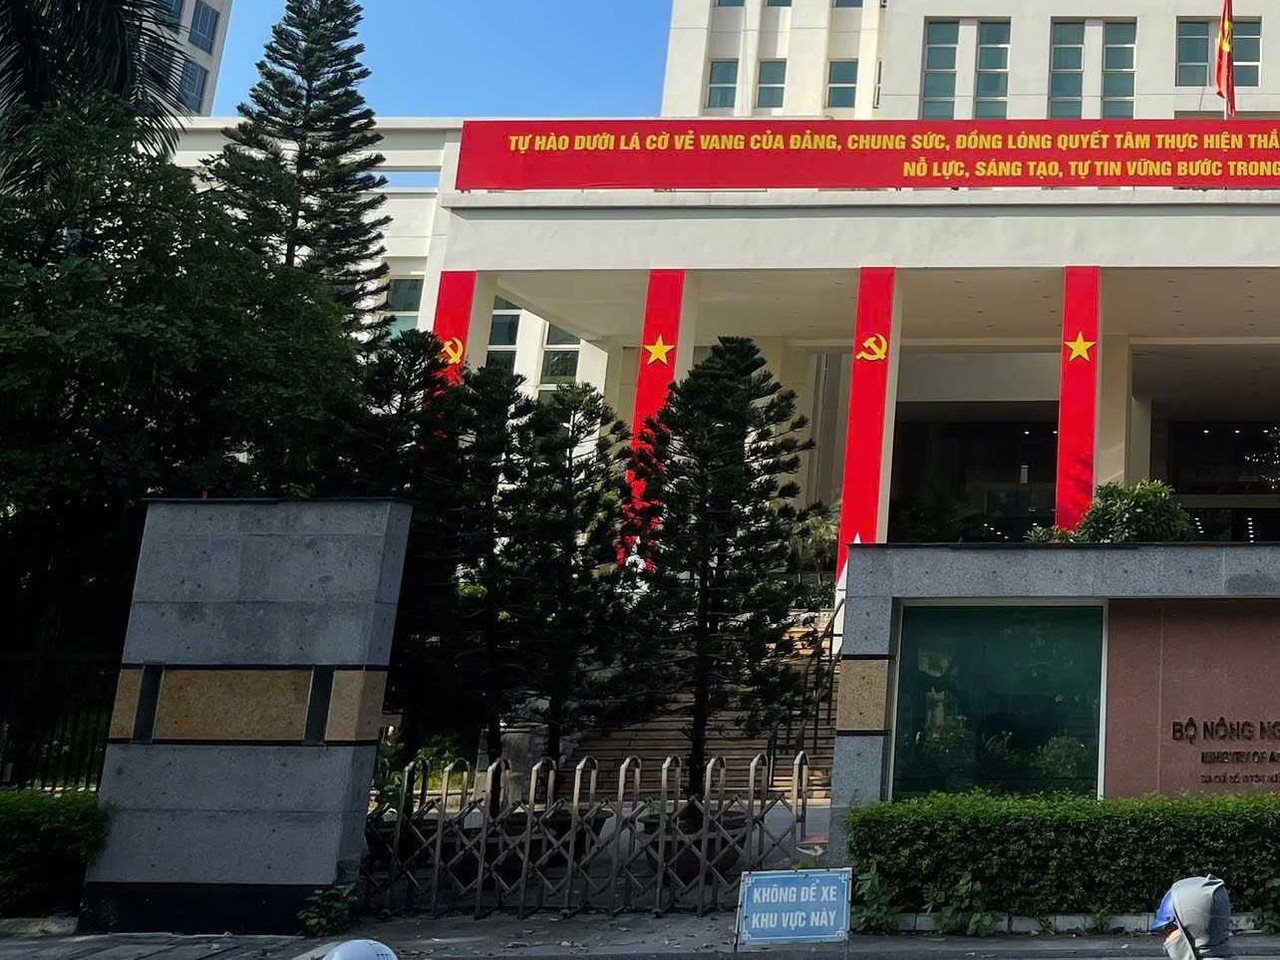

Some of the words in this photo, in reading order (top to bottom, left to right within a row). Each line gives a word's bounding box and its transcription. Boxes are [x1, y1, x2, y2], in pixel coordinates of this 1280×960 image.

[509, 134, 531, 153] TỰ
[535, 132, 569, 150] HÀO
[574, 132, 615, 150] DƯỚI
[620, 132, 640, 149] LÁ
[646, 132, 669, 150] CỜ
[674, 130, 694, 149] VẺ
[700, 135, 745, 149] VANG
[750, 130, 784, 149] CỦA
[790, 130, 842, 150] ĐẢNG,
[848, 135, 906, 149] CHUNG
[911, 132, 950, 150] SỨC,
[956, 130, 1003, 149] ĐỒNG
[1008, 131, 1052, 149] LÒNG
[1057, 130, 1109, 150] QUYẾT
[1114, 132, 1150, 148] TÂM
[1155, 133, 1198, 152] THỰC
[1204, 131, 1242, 151] HIỆN
[903, 157, 927, 177] NỖ
[933, 160, 970, 179] LỰC,
[975, 159, 1022, 176] SÁNG
[1027, 161, 1063, 179] TẠO,
[1069, 160, 1091, 179] TỰ
[1094, 161, 1121, 176] TIN
[1127, 159, 1172, 176] VỮNG
[1177, 158, 1222, 176] BƯỚC
[1172, 717, 1197, 744] BỘ
[1203, 716, 1254, 741] NÔNG
[753, 884, 797, 903] KHÔNG
[821, 885, 837, 901] XE
[752, 912, 778, 929] KHU
[781, 910, 807, 930] VỰC
[810, 907, 837, 926] NÀY
